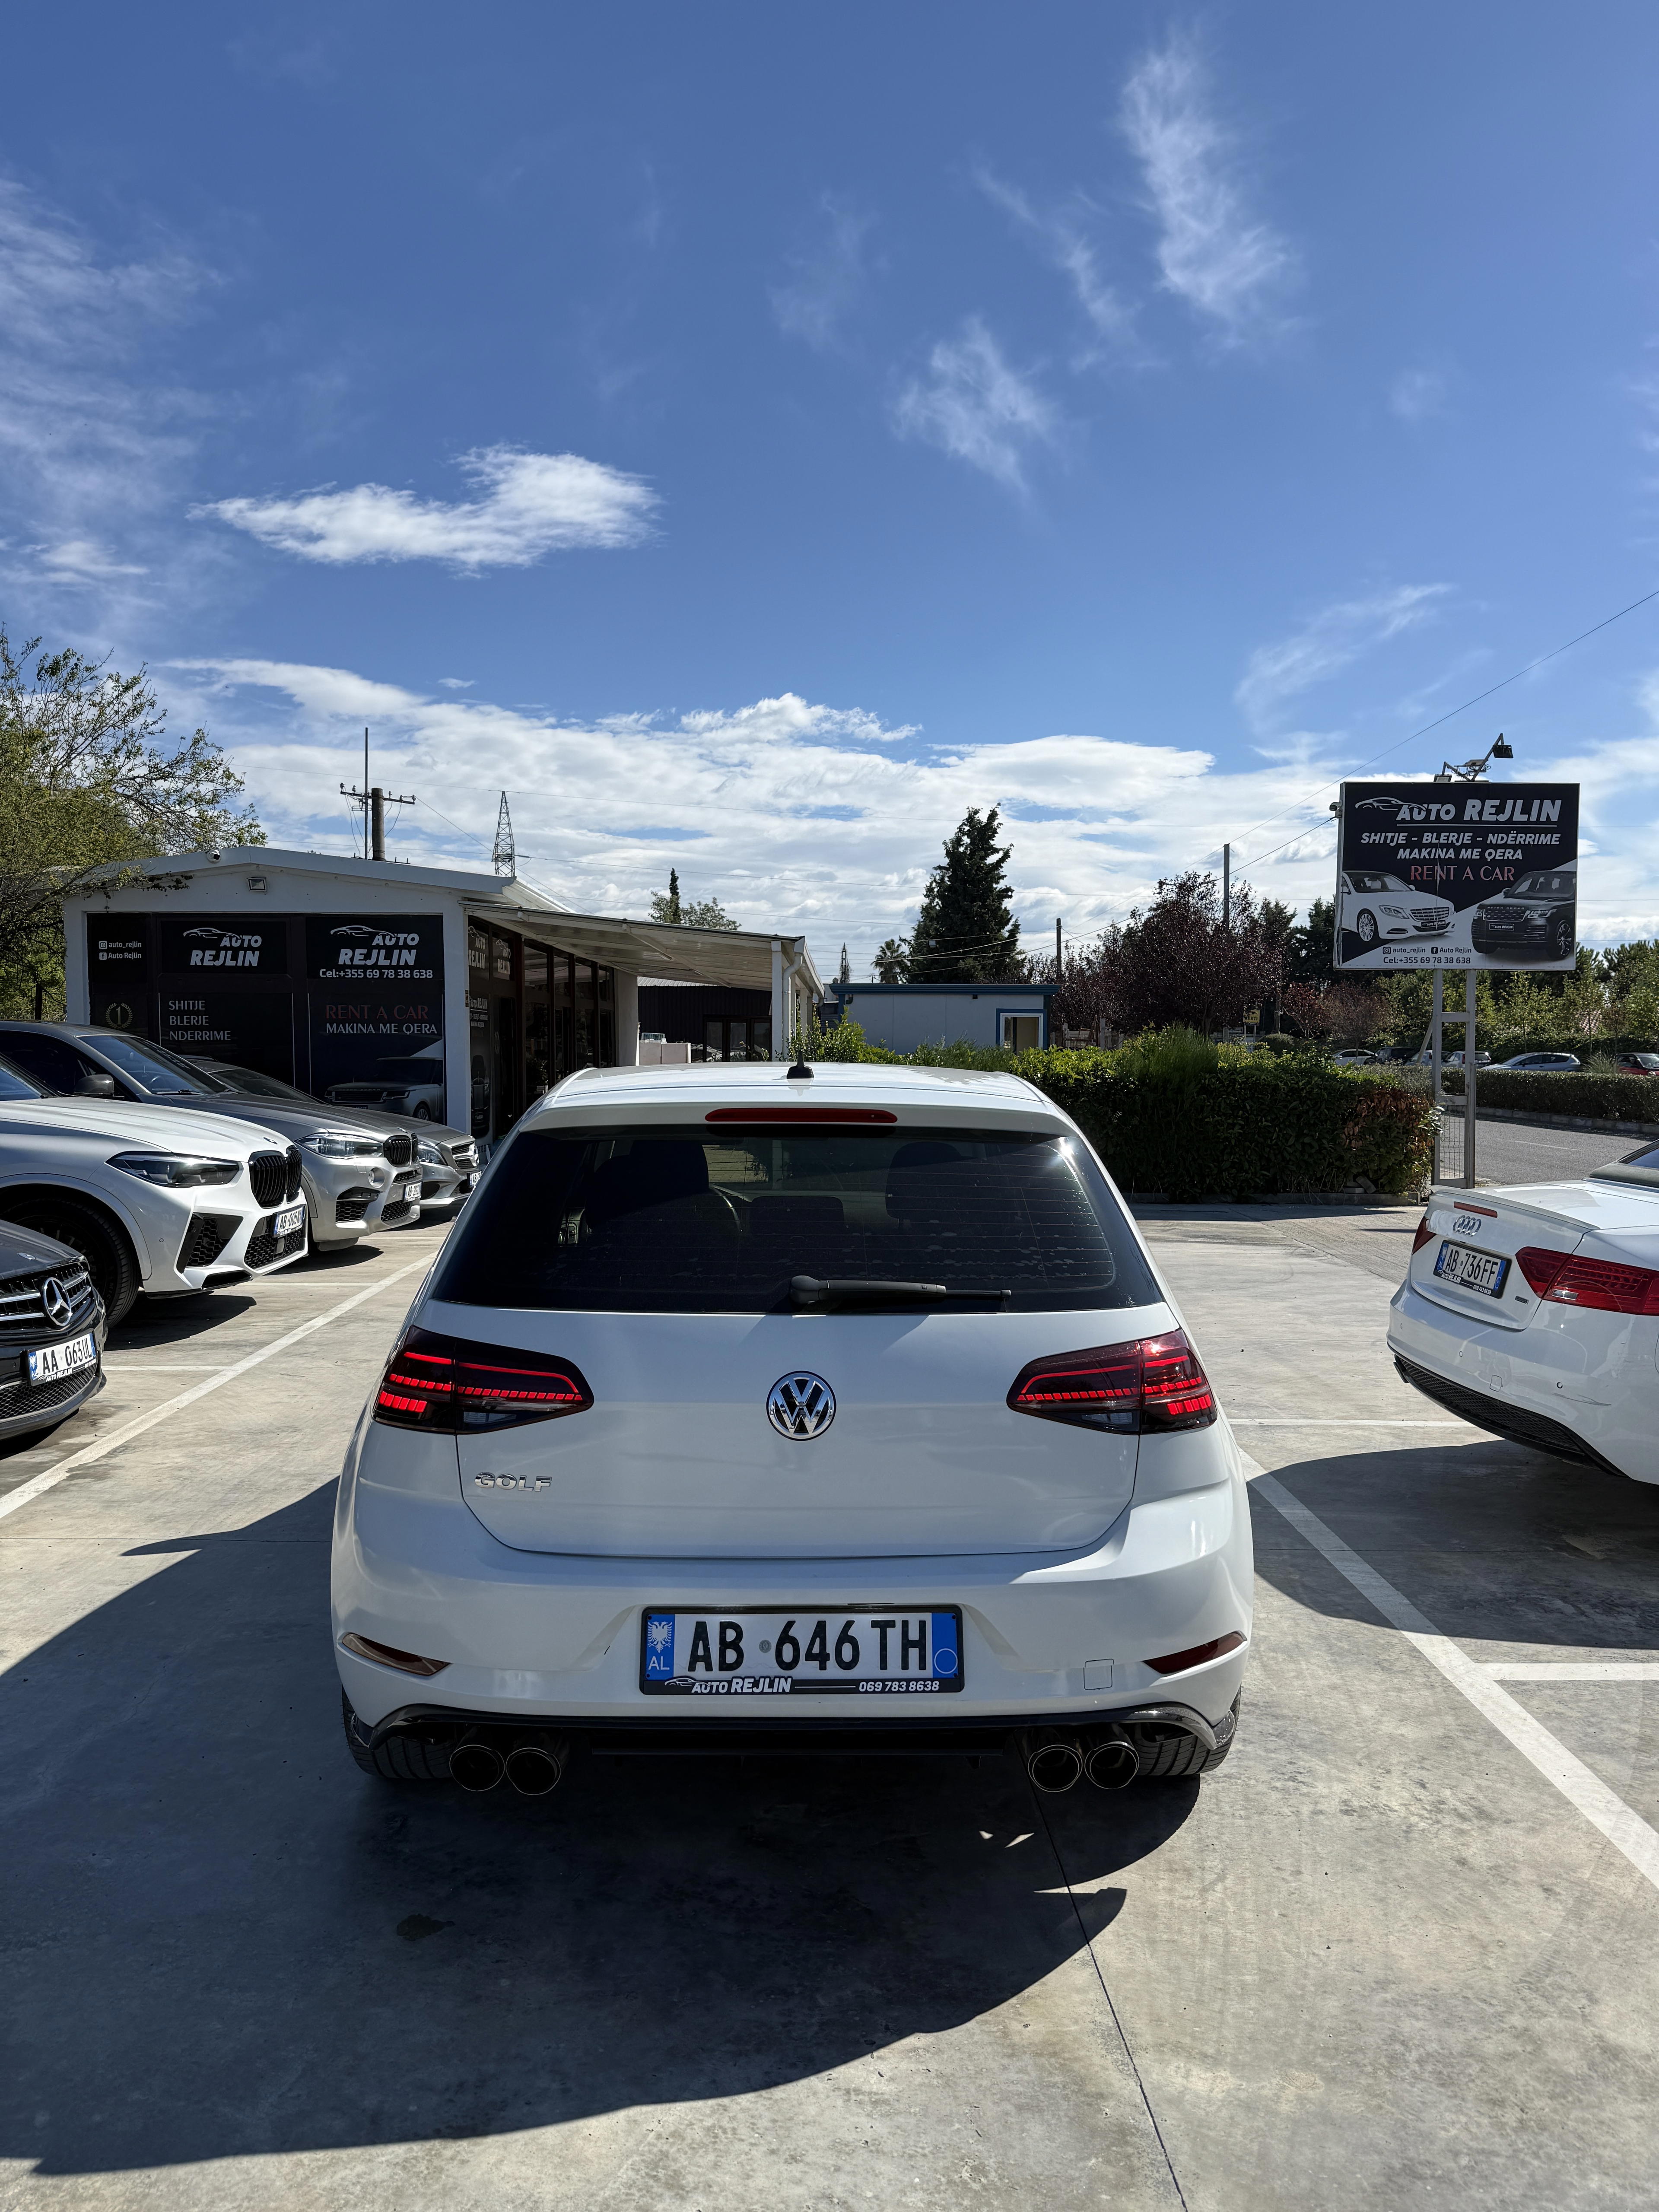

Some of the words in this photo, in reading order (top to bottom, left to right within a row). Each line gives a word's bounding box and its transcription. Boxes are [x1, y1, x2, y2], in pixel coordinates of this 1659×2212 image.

[1396, 804, 1456, 820] AUTO
[1463, 799, 1561, 821] REJLIN
[1361, 833, 1408, 846] SHITJE
[1422, 833, 1473, 846] BLERJE
[1487, 830, 1560, 845] NDËRRIME
[1397, 848, 1455, 859] MAKINA
[1459, 848, 1481, 859] ME
[1485, 849, 1522, 861] QERA
[1411, 865, 1457, 880] RENT
[1462, 866, 1474, 880] A
[1480, 866, 1515, 881] CAR
[220, 935, 262, 947] AUTO
[372, 933, 419, 946] AUTO
[190, 950, 259, 966] REJLIN
[338, 949, 416, 965] REJLIN
[320, 969, 364, 978] Cel:+355
[366, 969, 379, 978] 69
[382, 969, 395, 978] 78
[397, 969, 410, 978] 38
[413, 969, 433, 979] 638
[168, 1000, 205, 1010] SHITJE
[325, 1005, 371, 1020] RENT
[376, 1006, 388, 1020] A
[394, 1005, 428, 1019] CAR
[169, 1015, 210, 1025] BLERJE
[170, 1031, 231, 1041] NDERRIME
[326, 1023, 375, 1033] MAKINA
[380, 1023, 398, 1033] ME
[403, 1023, 438, 1035] QERA
[280, 1215, 287, 1230] AB
[1445, 1249, 1459, 1272] AB
[43, 1350, 59, 1374] AA
[46, 1374, 57, 1382] AUTO
[57, 1367, 73, 1379] REJLIN
[474, 1472, 552, 1492] GOLF
[687, 1620, 744, 1672] AB
[648, 1656, 670, 1671] AL
[691, 1681, 728, 1693] AUTO
[731, 1678, 792, 1693] REJLIN
[859, 1681, 882, 1692] 069
[884, 1681, 906, 1692] 783
[909, 1681, 939, 1691] 8638
